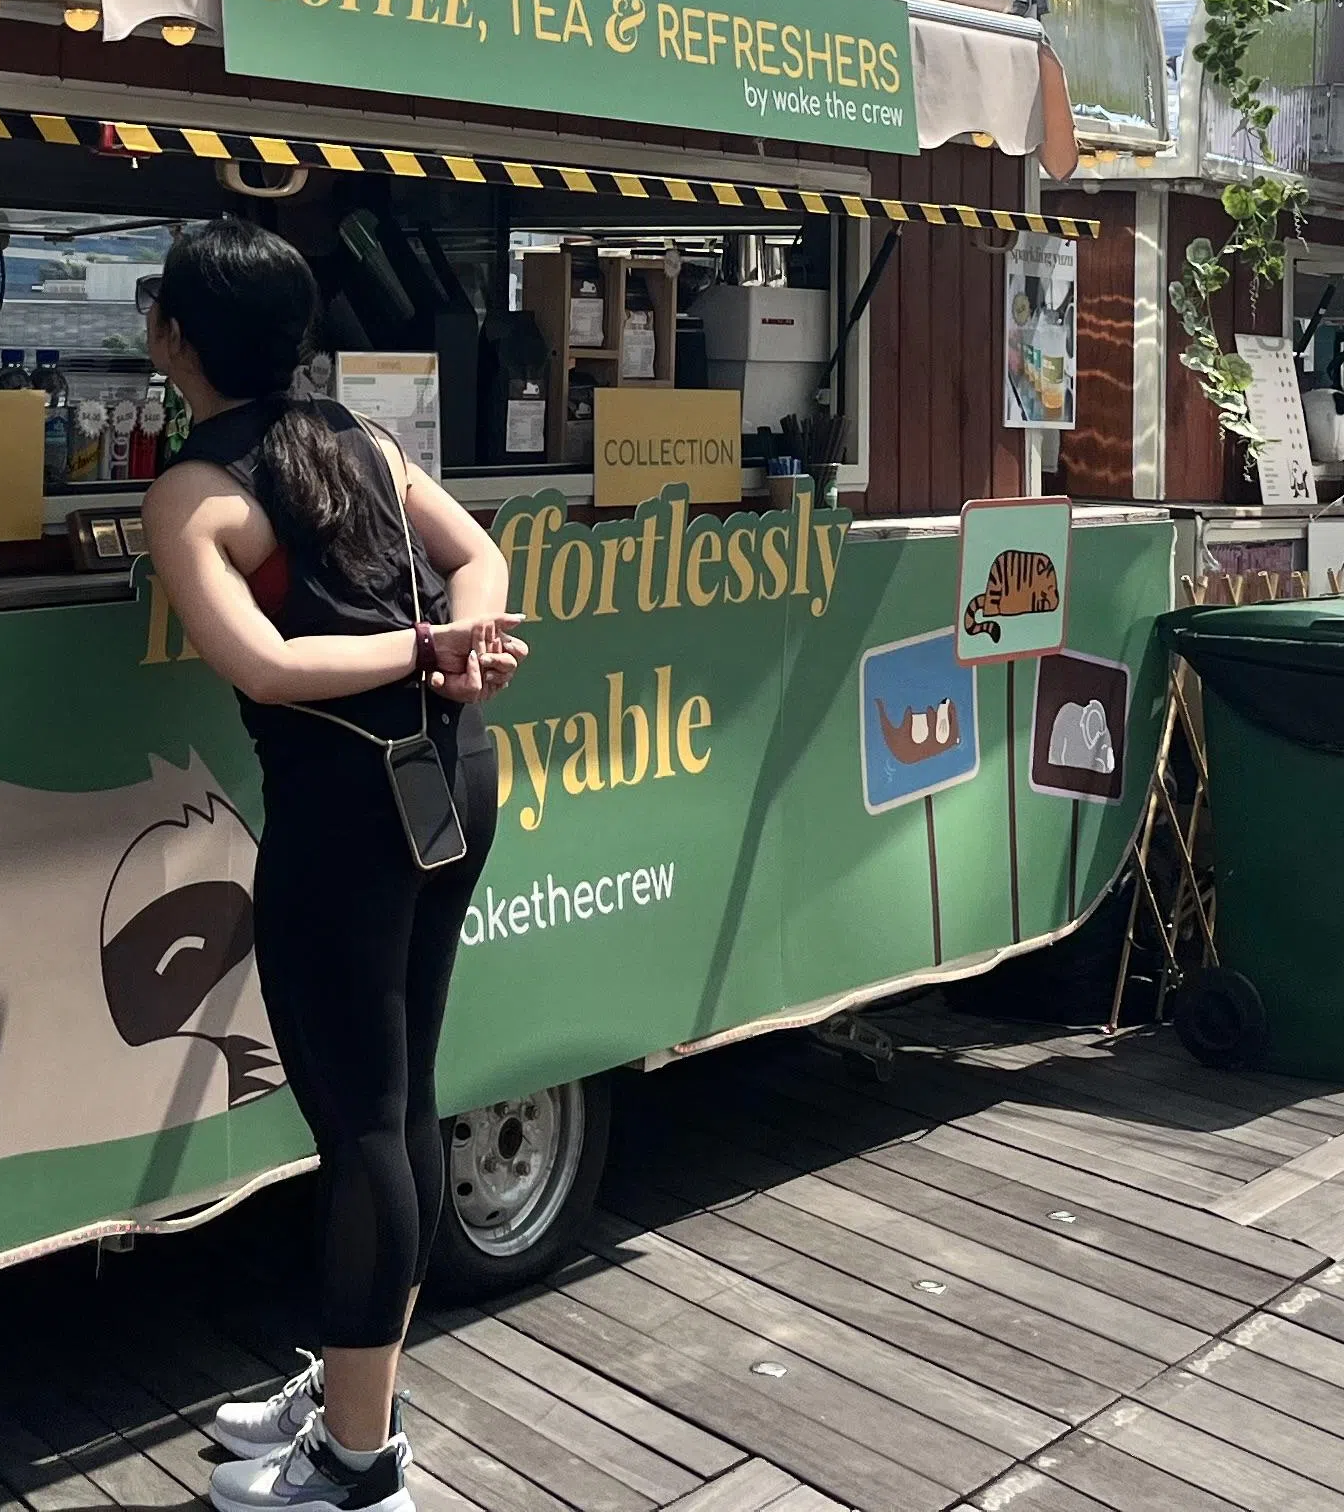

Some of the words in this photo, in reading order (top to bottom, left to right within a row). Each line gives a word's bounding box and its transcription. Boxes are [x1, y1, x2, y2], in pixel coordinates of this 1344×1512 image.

[657, 2, 901, 94] REFRESHERS
[744, 78, 769, 117] by
[772, 87, 821, 119] wake
[824, 93, 858, 122] the
[861, 102, 904, 127] crew
[603, 438, 734, 467] COLLECTION
